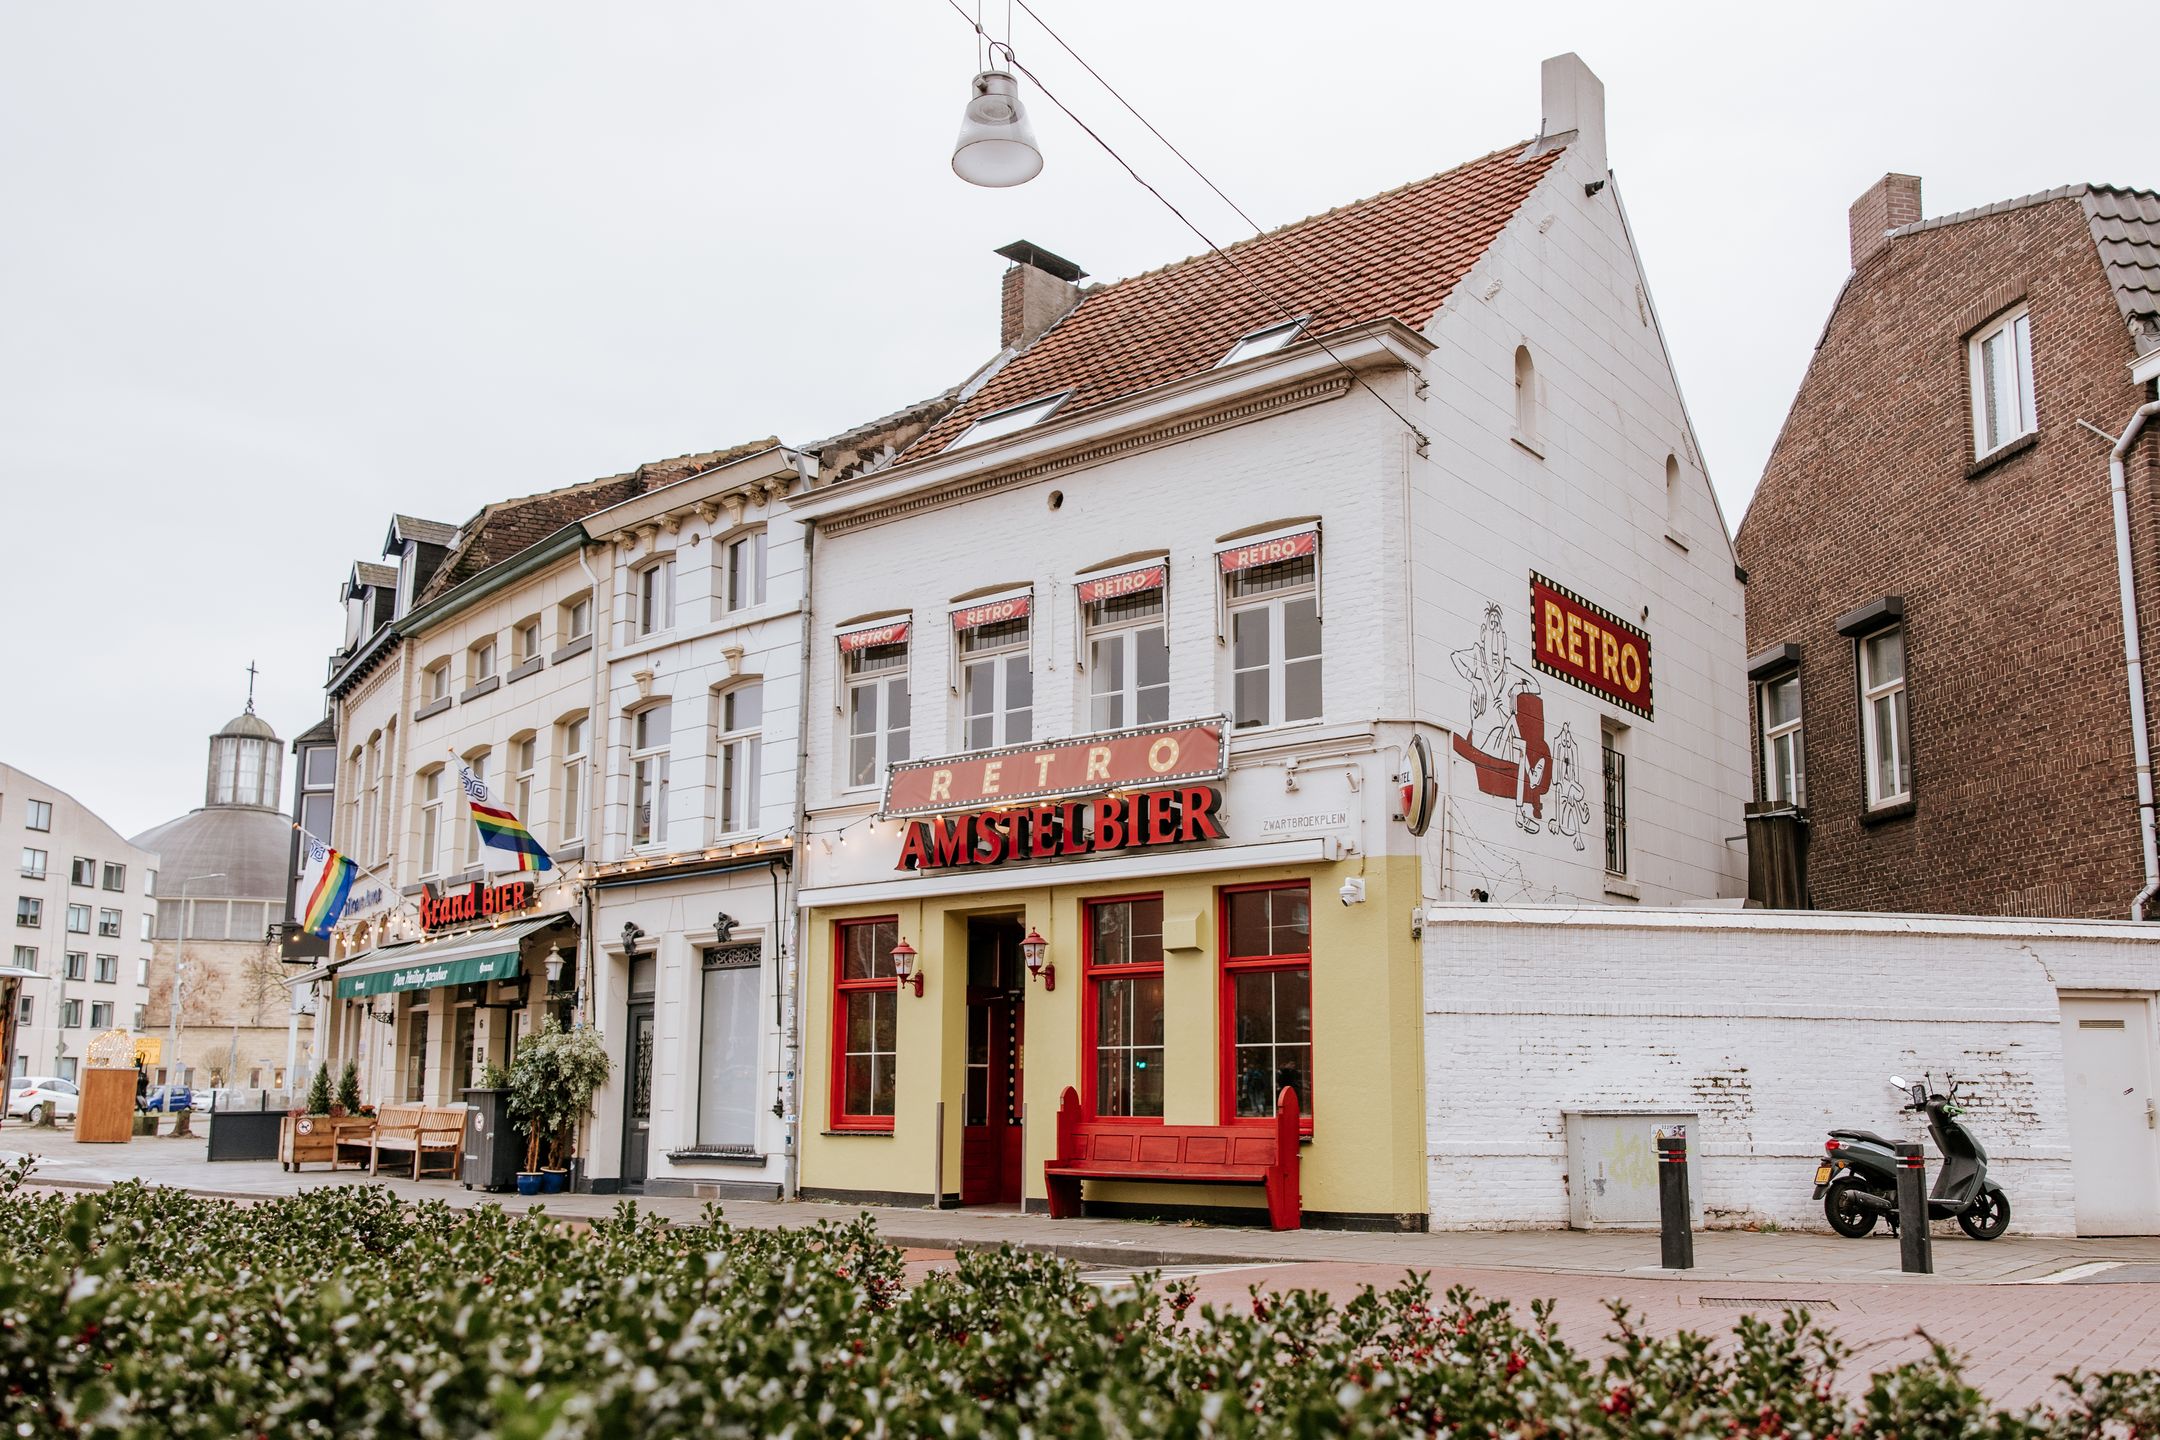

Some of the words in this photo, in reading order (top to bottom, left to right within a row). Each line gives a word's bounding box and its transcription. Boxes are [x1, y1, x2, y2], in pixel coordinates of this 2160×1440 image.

[1237, 539, 1297, 567] RETRO
[1093, 572, 1147, 598] RETRO
[966, 602, 1014, 625] RETRO
[850, 628, 894, 647] RETRO
[1544, 599, 1642, 693] RETRO
[929, 736, 1180, 802] RETRO
[1263, 812, 1347, 831] ZWARTBROEKPLEIN
[419, 881, 476, 934] Brand
[482, 881, 528, 916] BIER
[479, 1018, 484, 1030] 6
